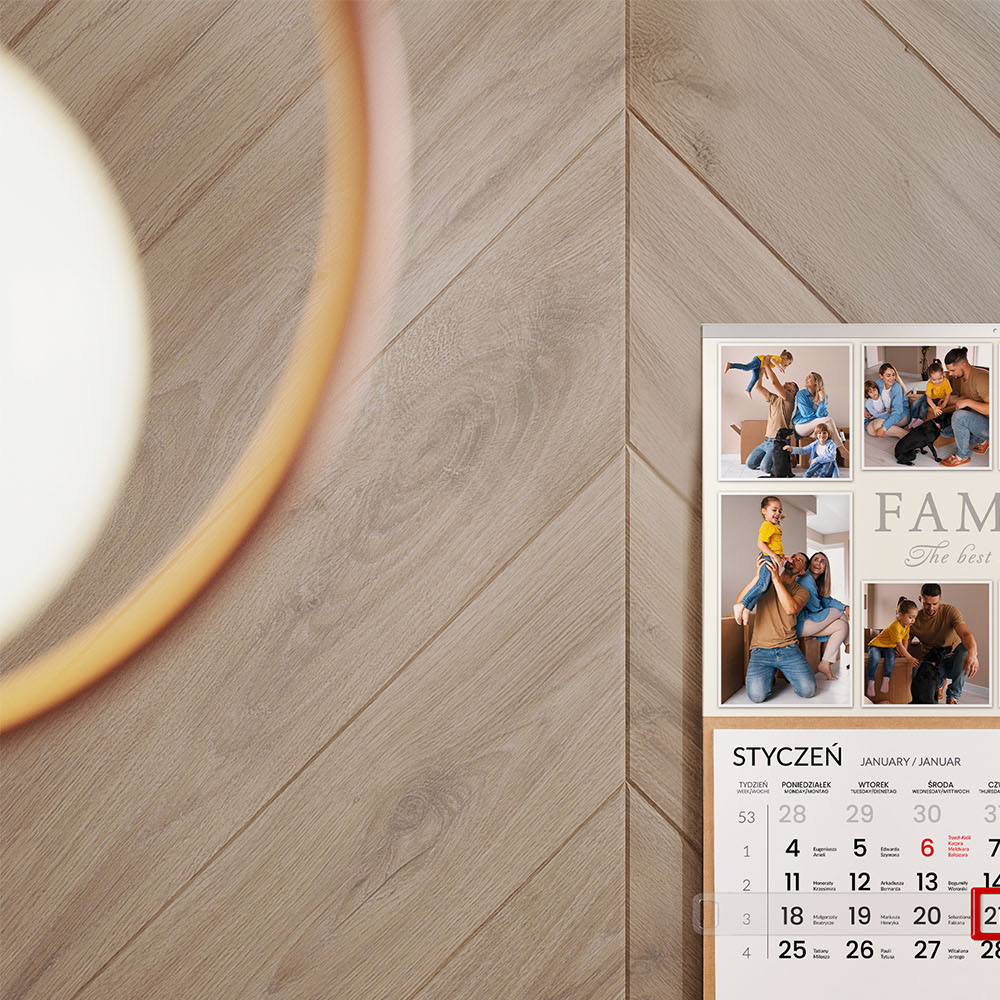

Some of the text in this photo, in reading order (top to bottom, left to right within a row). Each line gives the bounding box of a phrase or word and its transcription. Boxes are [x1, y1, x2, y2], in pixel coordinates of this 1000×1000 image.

[904, 540, 950, 567] The
[957, 543, 992, 564] best
[733, 743, 841, 766] STYCZEŃ
[861, 757, 910, 766] JANUARY
[919, 757, 961, 766] JANUAR
[739, 780, 768, 788] TYDZIEŃ
[927, 780, 954, 788] ŚRODA
[739, 811, 755, 823] 53
[779, 805, 806, 823] 28
[846, 804, 873, 823] 29
[913, 805, 941, 823] 30
[744, 845, 750, 857] 1
[786, 839, 800, 857] 4
[854, 839, 867, 857] 5
[921, 838, 934, 857] 6
[989, 839, 1000, 857] 7
[743, 879, 750, 891] 2
[785, 873, 799, 891] 11
[850, 872, 870, 891] 12
[917, 872, 938, 891] 13
[743, 913, 750, 925] 3
[782, 906, 803, 925] 18
[849, 906, 870, 925] 19
[914, 906, 941, 925] 20
[742, 947, 751, 958] 4
[779, 940, 806, 959] 25
[846, 940, 873, 959] 26
[915, 940, 940, 959] 27
